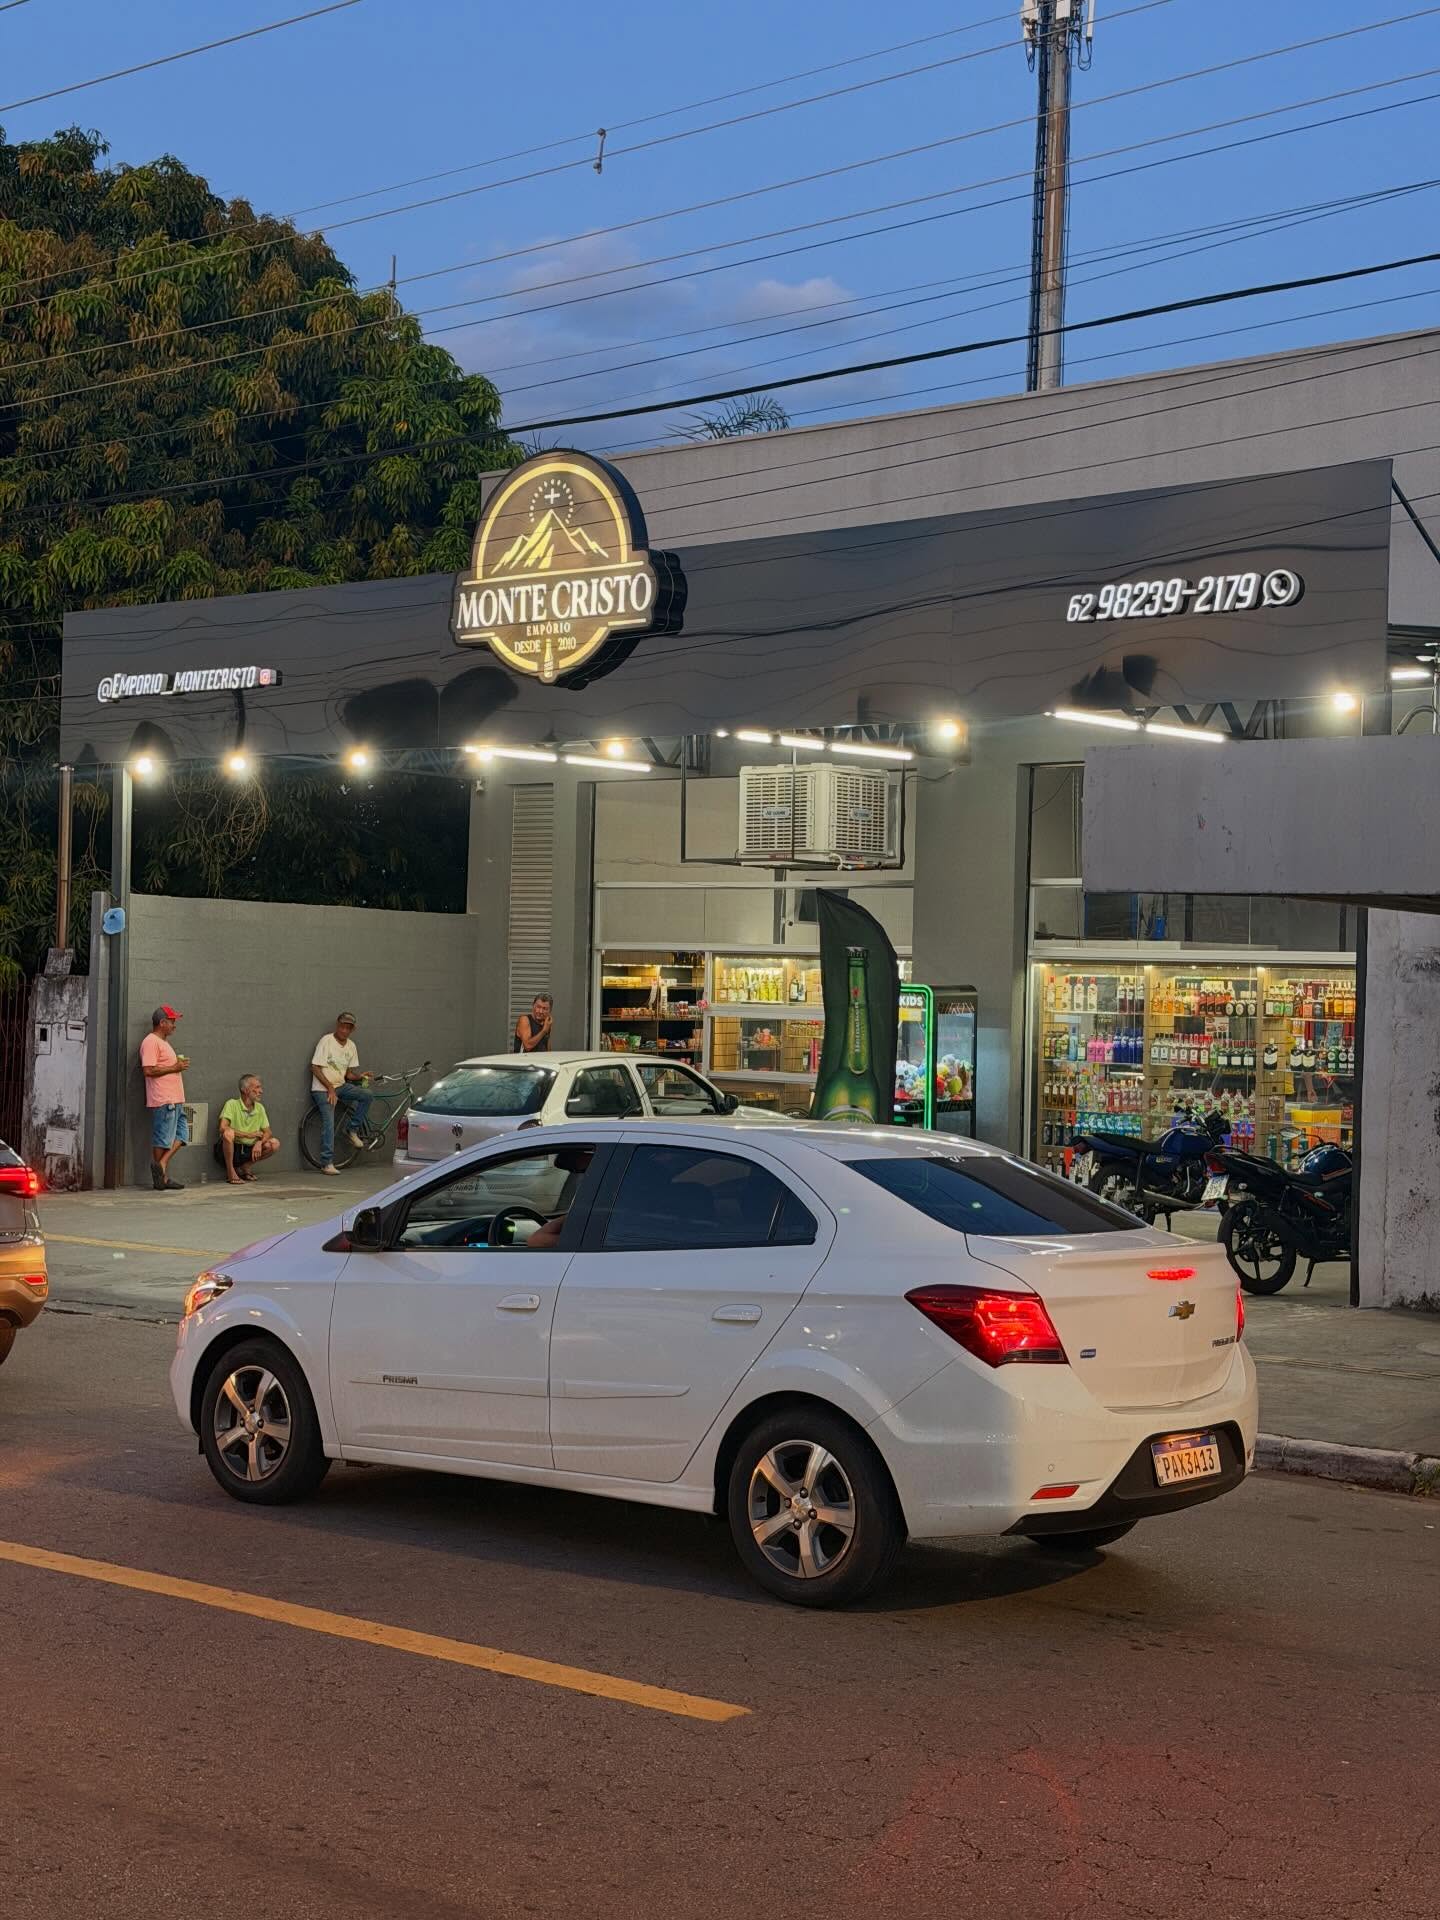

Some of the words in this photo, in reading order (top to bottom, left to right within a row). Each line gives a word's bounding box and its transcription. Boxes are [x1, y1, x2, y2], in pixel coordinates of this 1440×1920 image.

[456, 583, 547, 629] MONTE
[551, 573, 652, 619] CRISTO
[1066, 593, 1095, 622] 62
[1096, 572, 1257, 620] 98239-2179
[526, 621, 571, 637] EMPÓRIO
[514, 638, 542, 654] DESDE
[558, 636, 576, 651] 2010
[899, 995, 923, 1007] KIDS
[382, 1374, 418, 1385] PRISMA
[1162, 1447, 1215, 1480] PAX3A13
